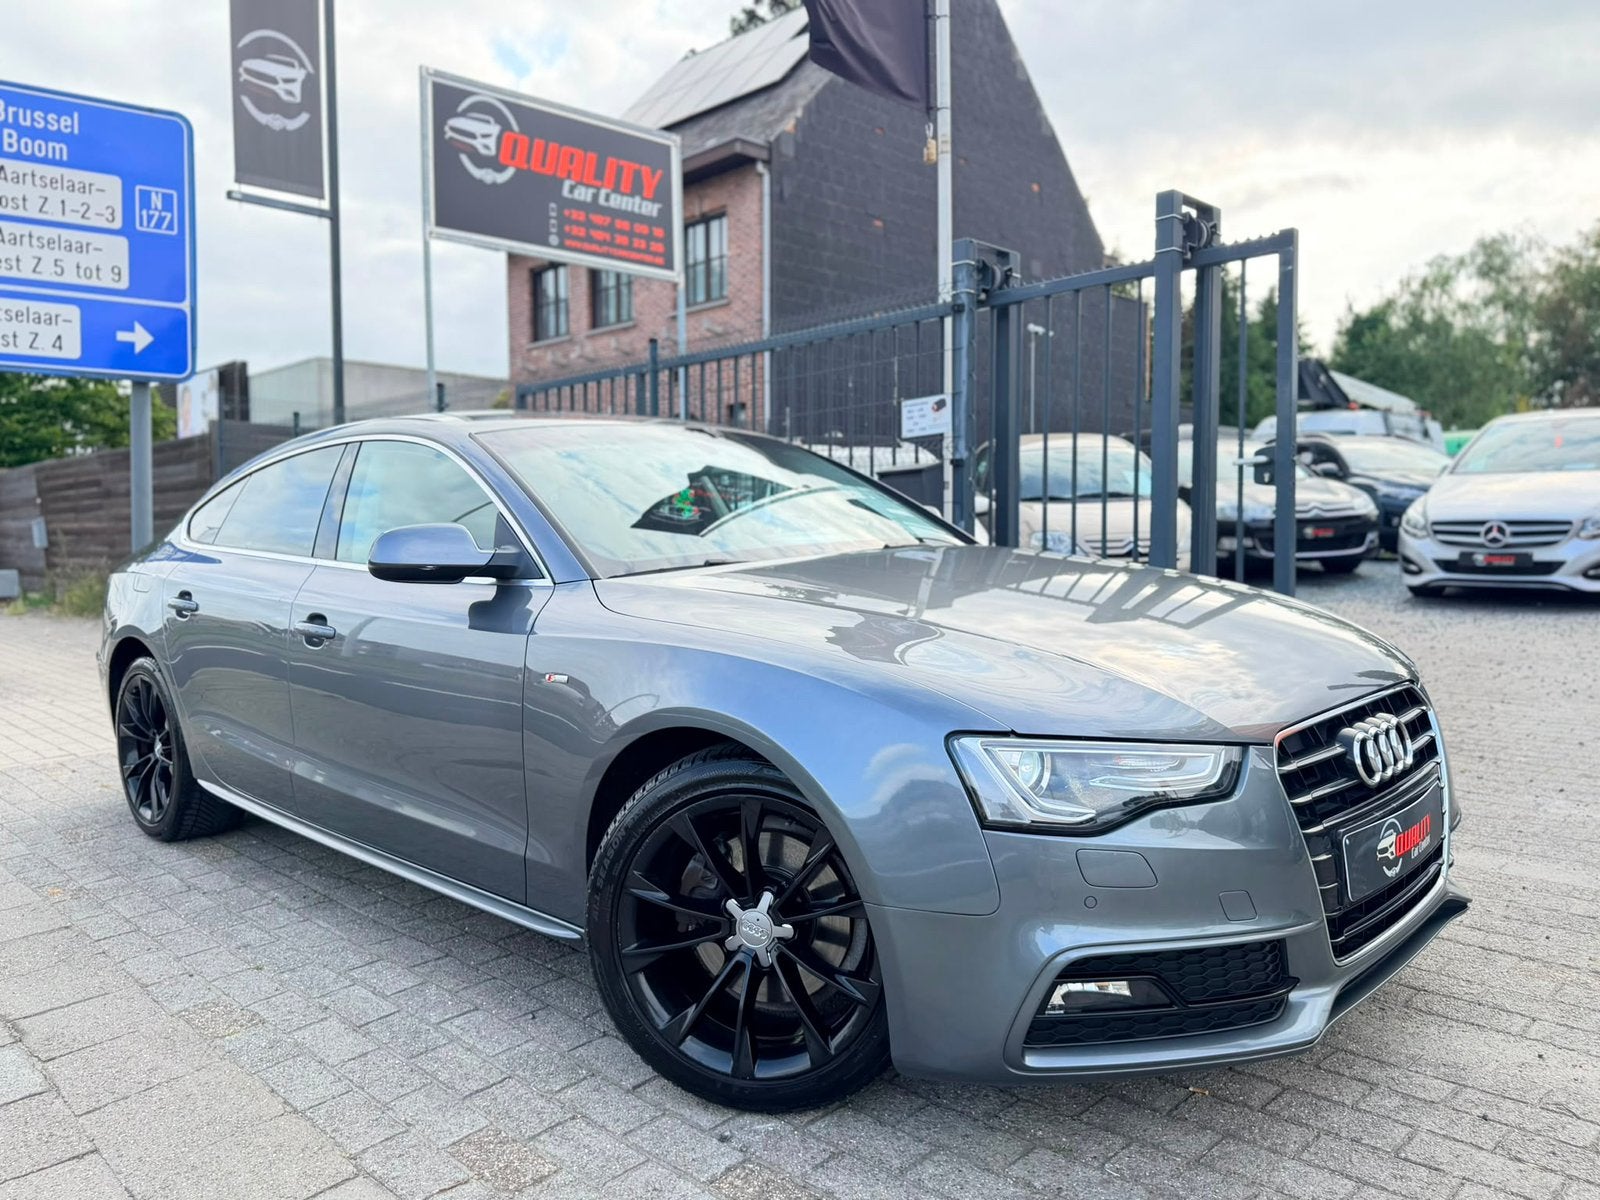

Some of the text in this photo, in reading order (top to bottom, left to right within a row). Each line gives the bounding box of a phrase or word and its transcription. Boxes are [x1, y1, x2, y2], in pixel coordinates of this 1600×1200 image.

[3, 128, 68, 161] Boom
[0, 164, 106, 195] Aartselaar-
[499, 131, 662, 198] QUALITY
[60, 199, 116, 224] 1-2-3
[151, 191, 162, 211] N
[562, 179, 662, 217] Car Center
[141, 208, 172, 230] 177
[0, 254, 22, 273] st
[76, 261, 102, 281] tot
[110, 264, 123, 283] 9
[0, 305, 73, 327] selaar-
[51, 333, 63, 353] 4
[1397, 815, 1430, 857] QUALITY
[597, 827, 626, 888] SEASON
